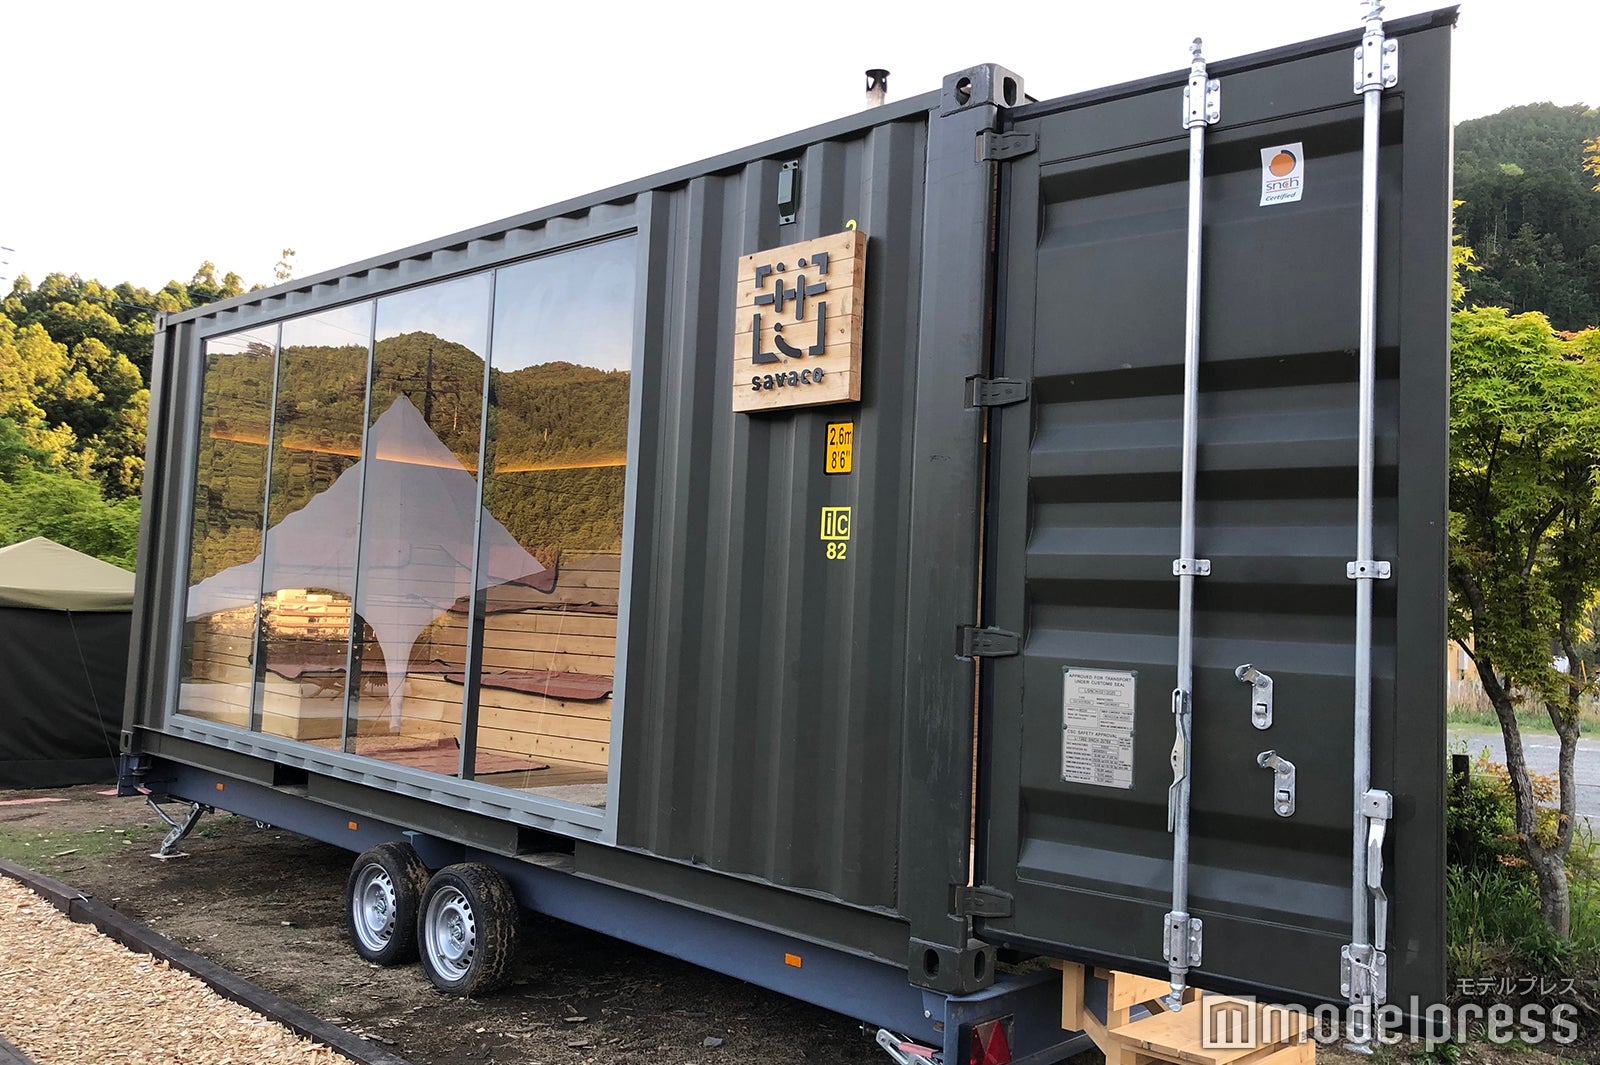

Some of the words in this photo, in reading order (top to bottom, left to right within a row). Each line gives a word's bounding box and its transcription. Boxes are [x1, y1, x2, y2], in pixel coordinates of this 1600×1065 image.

[1266, 177, 1299, 190] snch
[1265, 192, 1297, 201] Certified
[751, 367, 824, 392] savaco
[826, 542, 847, 560] 82
